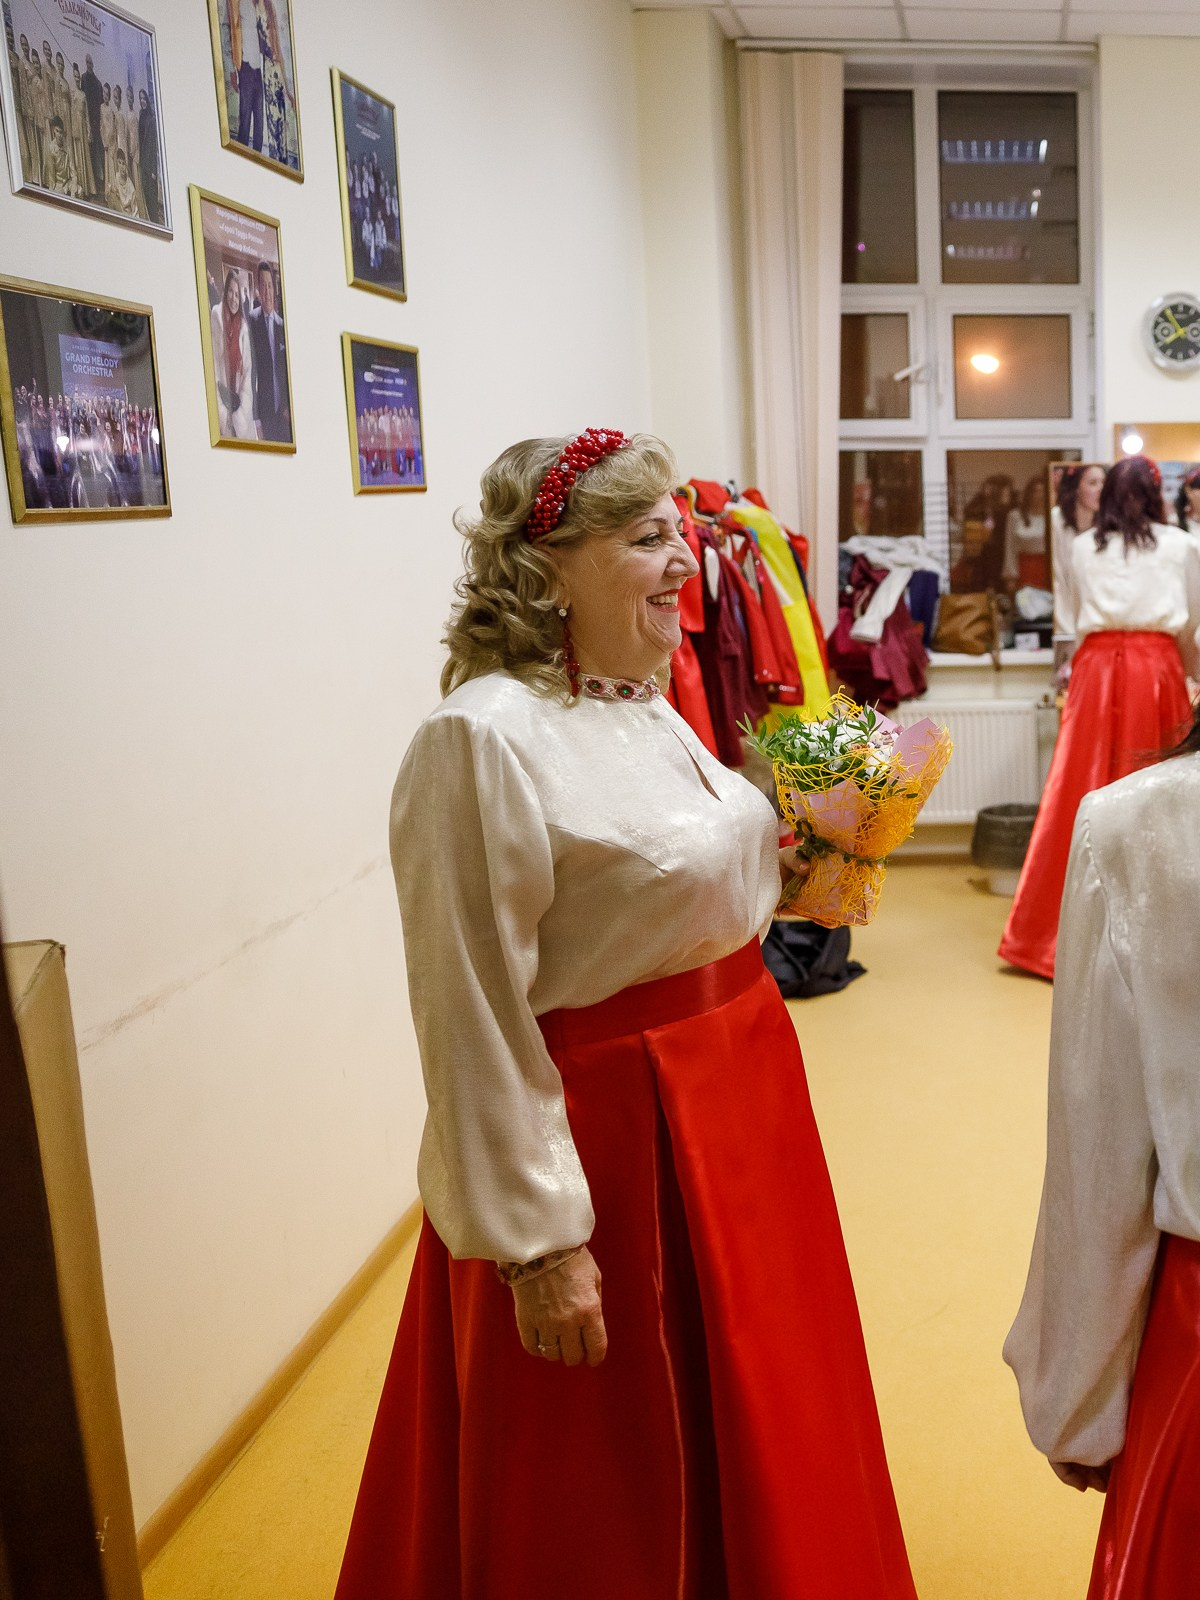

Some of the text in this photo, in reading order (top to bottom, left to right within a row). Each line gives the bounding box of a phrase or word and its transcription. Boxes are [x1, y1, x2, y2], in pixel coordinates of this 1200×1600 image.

[65, 352, 119, 369] GRAND MELODY
[72, 363, 114, 378] ORCHESTRA
